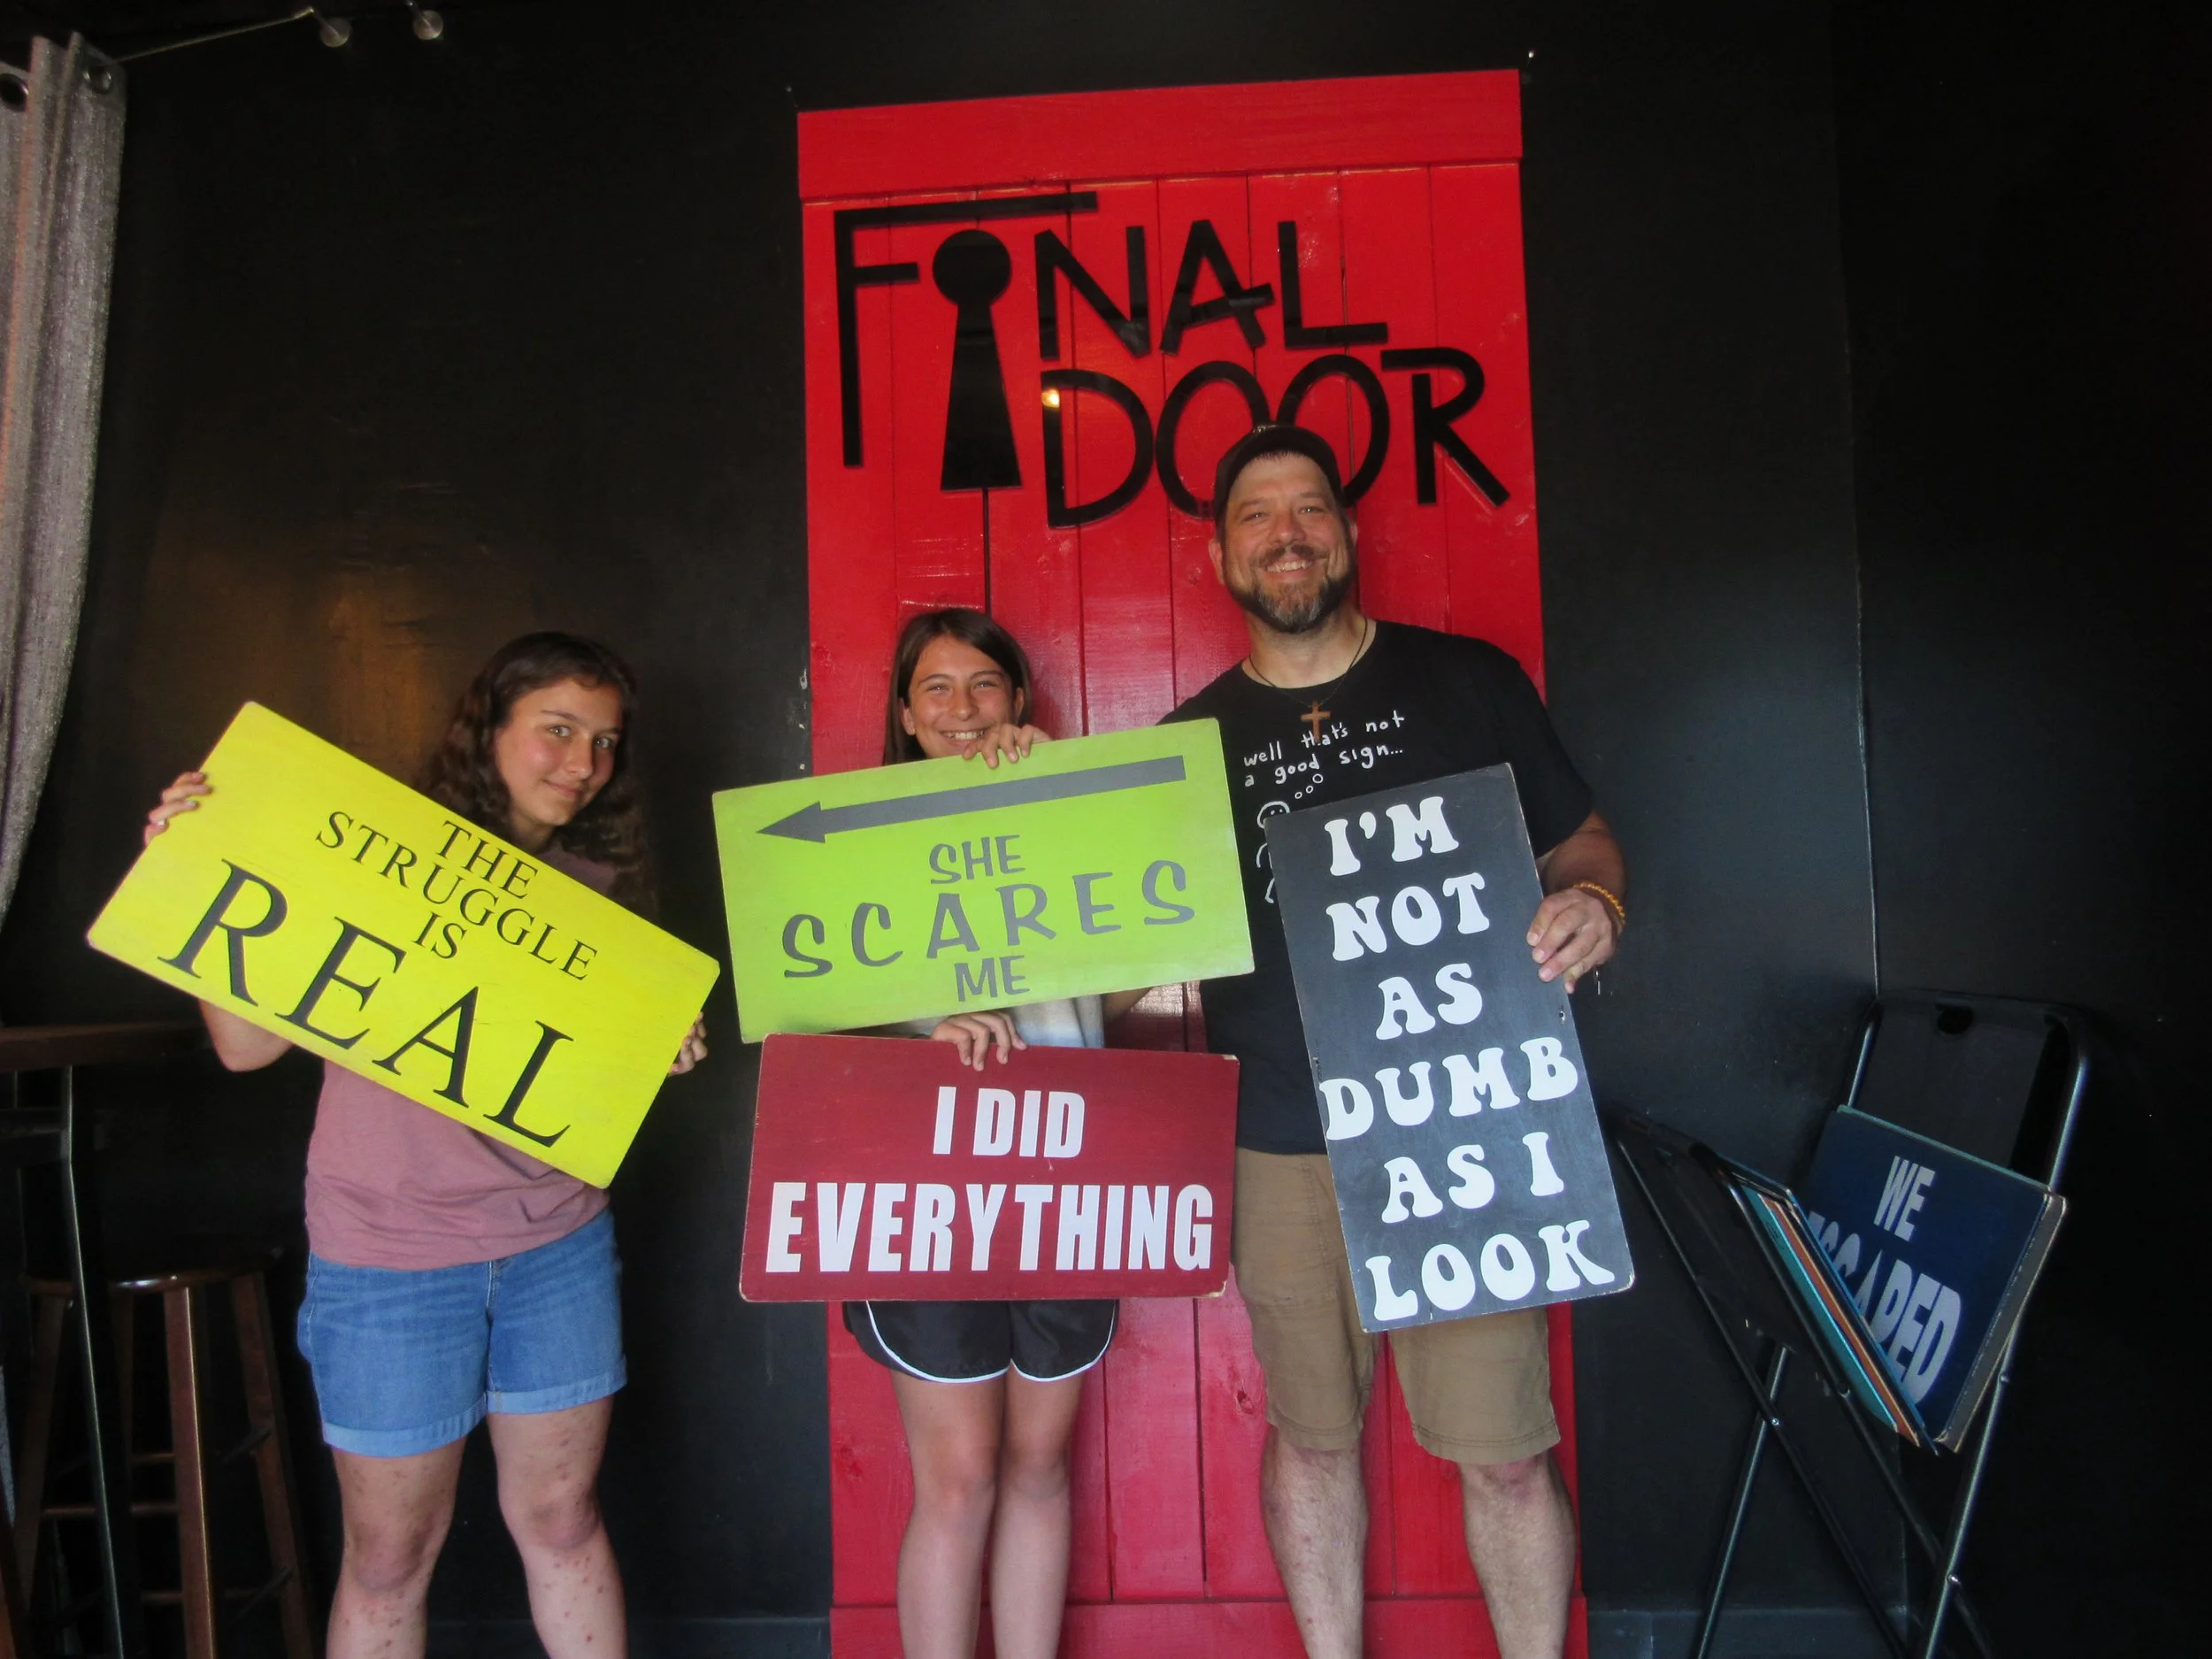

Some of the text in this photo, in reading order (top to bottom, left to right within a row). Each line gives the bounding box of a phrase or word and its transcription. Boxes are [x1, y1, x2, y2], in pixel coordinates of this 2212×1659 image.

[833, 190, 1389, 492] FINAL
[1041, 346, 1510, 530] DOOR
[1243, 710, 1405, 767] well that's not
[1244, 743, 1404, 787] a good sign...
[434, 819, 539, 900] THE
[929, 833, 1027, 885] SHE
[1325, 795, 1460, 877] I'M
[315, 810, 598, 981] STRUGGLE
[413, 910, 466, 960] IS
[781, 859, 1195, 979] SCARES
[1325, 872, 1492, 963] NOT
[157, 858, 575, 1148] REAL
[954, 954, 1031, 1002] ME
[1375, 963, 1484, 1041] AS
[933, 1086, 1086, 1159] I DID
[1318, 1036, 1579, 1141] DUMB
[1380, 1131, 1565, 1225] AS I
[1872, 1155, 1936, 1242] WE
[764, 1181, 1214, 1274] EVERYTHING
[1364, 1218, 1616, 1323] LOOK
[1808, 1210, 1962, 1405] APED
